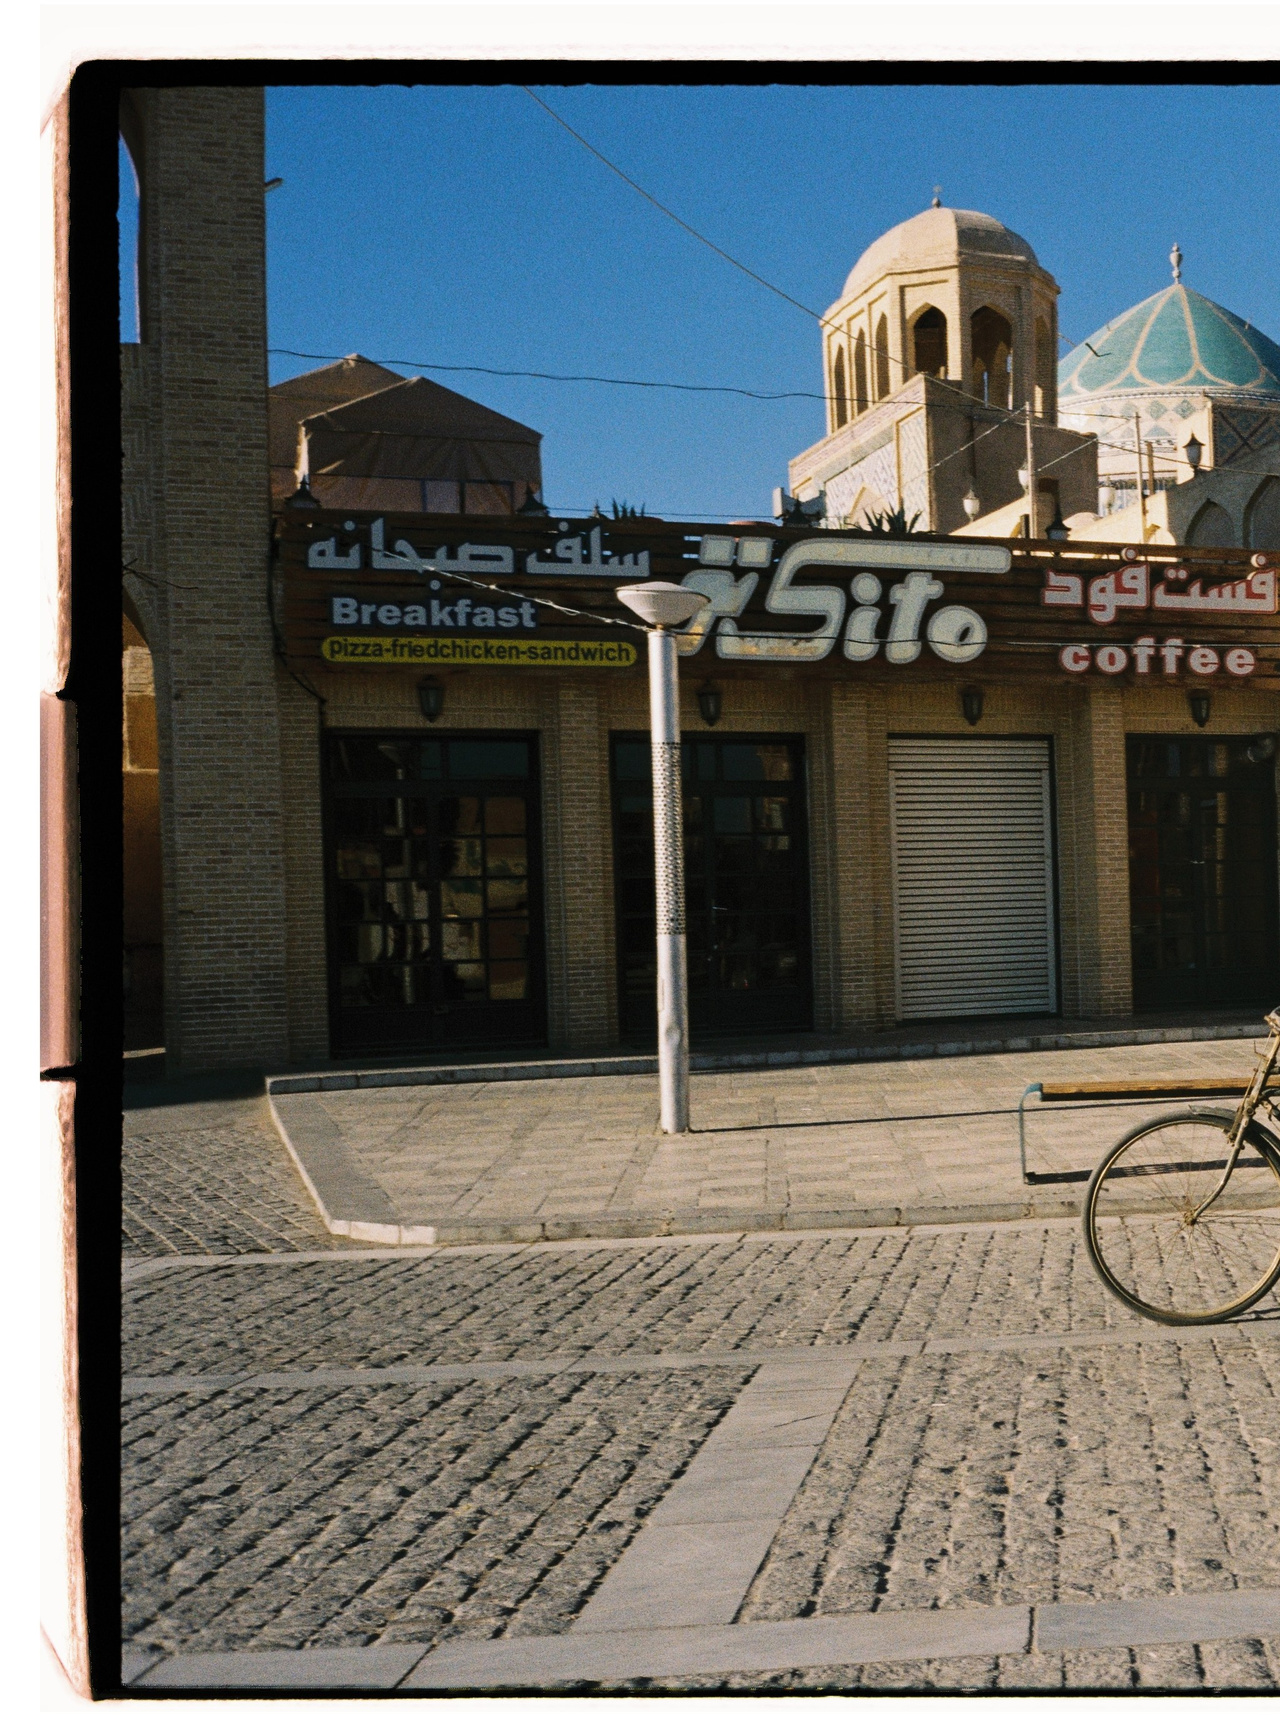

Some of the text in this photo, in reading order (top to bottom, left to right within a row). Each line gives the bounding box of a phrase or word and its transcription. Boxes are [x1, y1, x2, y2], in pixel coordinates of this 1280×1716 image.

[307, 517, 651, 592] سلف صبحانه
[331, 597, 537, 628] Breakfast
[716, 537, 1012, 664] Sito
[1042, 547, 1278, 625] فست فود
[328, 638, 632, 664] pizza-friedchicken-sandwich
[1060, 636, 1256, 675] coffee
